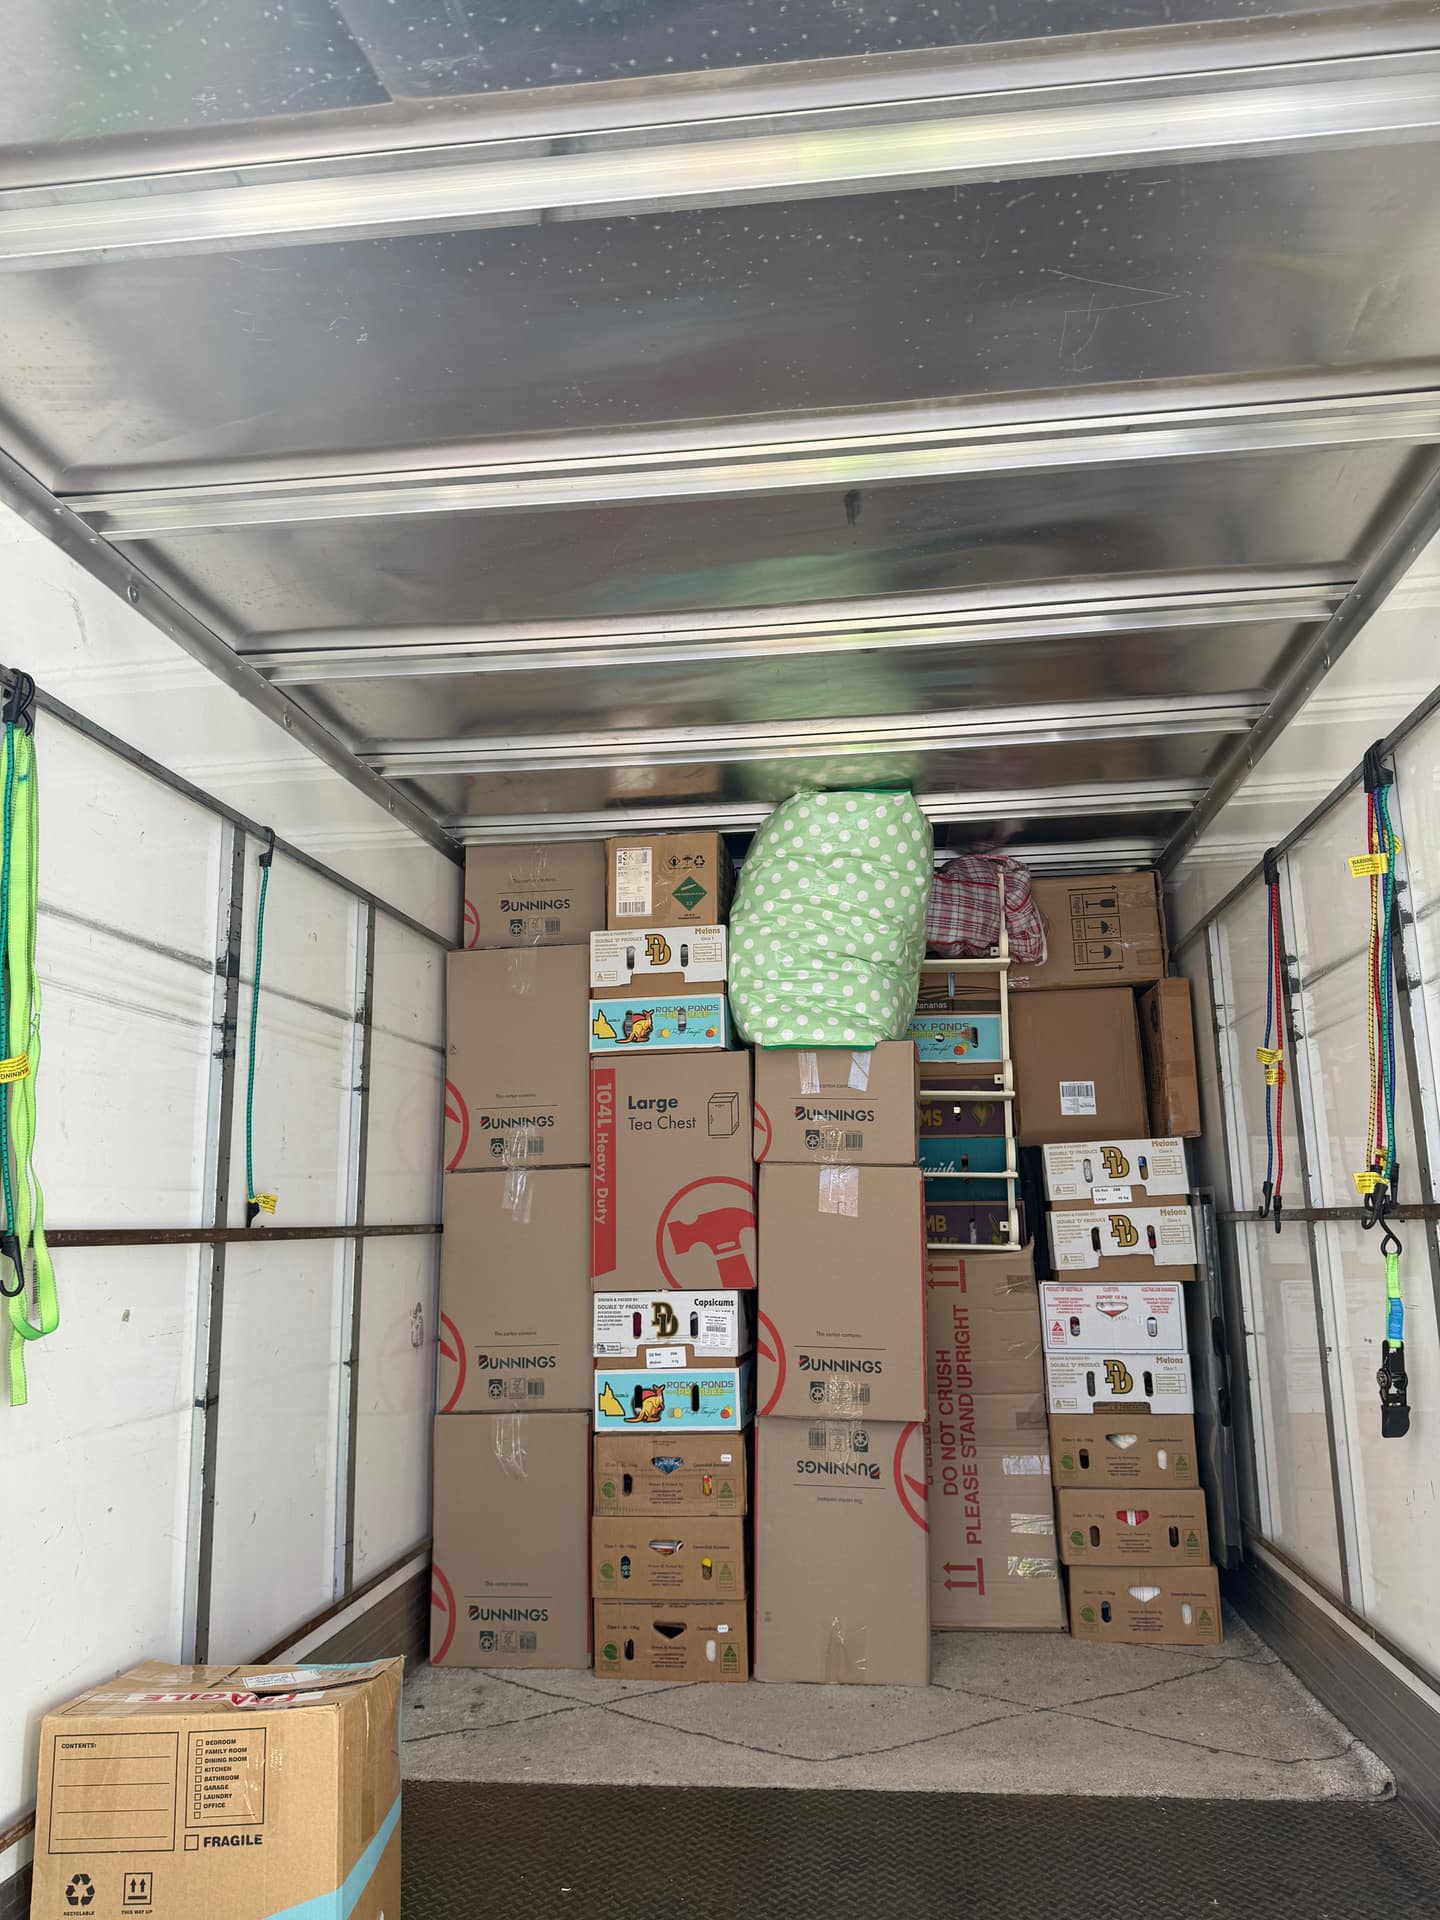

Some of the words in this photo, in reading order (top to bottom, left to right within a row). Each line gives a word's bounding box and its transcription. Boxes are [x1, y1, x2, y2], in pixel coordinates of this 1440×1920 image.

[500, 899, 570, 912] BUNNINGS
[695, 927, 721, 935] Melons
[596, 1083, 612, 1128] 104L
[628, 1096, 678, 1112] Large
[794, 1106, 874, 1122] BUNNINGS
[480, 1115, 555, 1130] BUNNINGS
[628, 1117, 652, 1131] Tea
[657, 1115, 697, 1130] Chest
[1151, 1140, 1179, 1148] Melons
[595, 1133, 608, 1182] Heavy
[594, 1189, 608, 1225] Duty
[694, 1298, 734, 1308] Capsicums
[953, 1304, 973, 1388] UPRIGHT
[478, 1354, 556, 1369] BUNNINGS
[798, 1355, 882, 1373] BUNNINGS
[1156, 1356, 1184, 1364] Melons
[701, 1380, 734, 1388] PONDS
[936, 1350, 954, 1415] CRUSH
[958, 1393, 976, 1458] STAND
[939, 1421, 956, 1460] NOT
[796, 1460, 880, 1480] BUNNINGS
[942, 1467, 958, 1496] DO
[962, 1463, 982, 1544] PLEASE
[468, 1605, 548, 1622] BUNNINGS
[203, 1834, 263, 1848] FRAGILE
